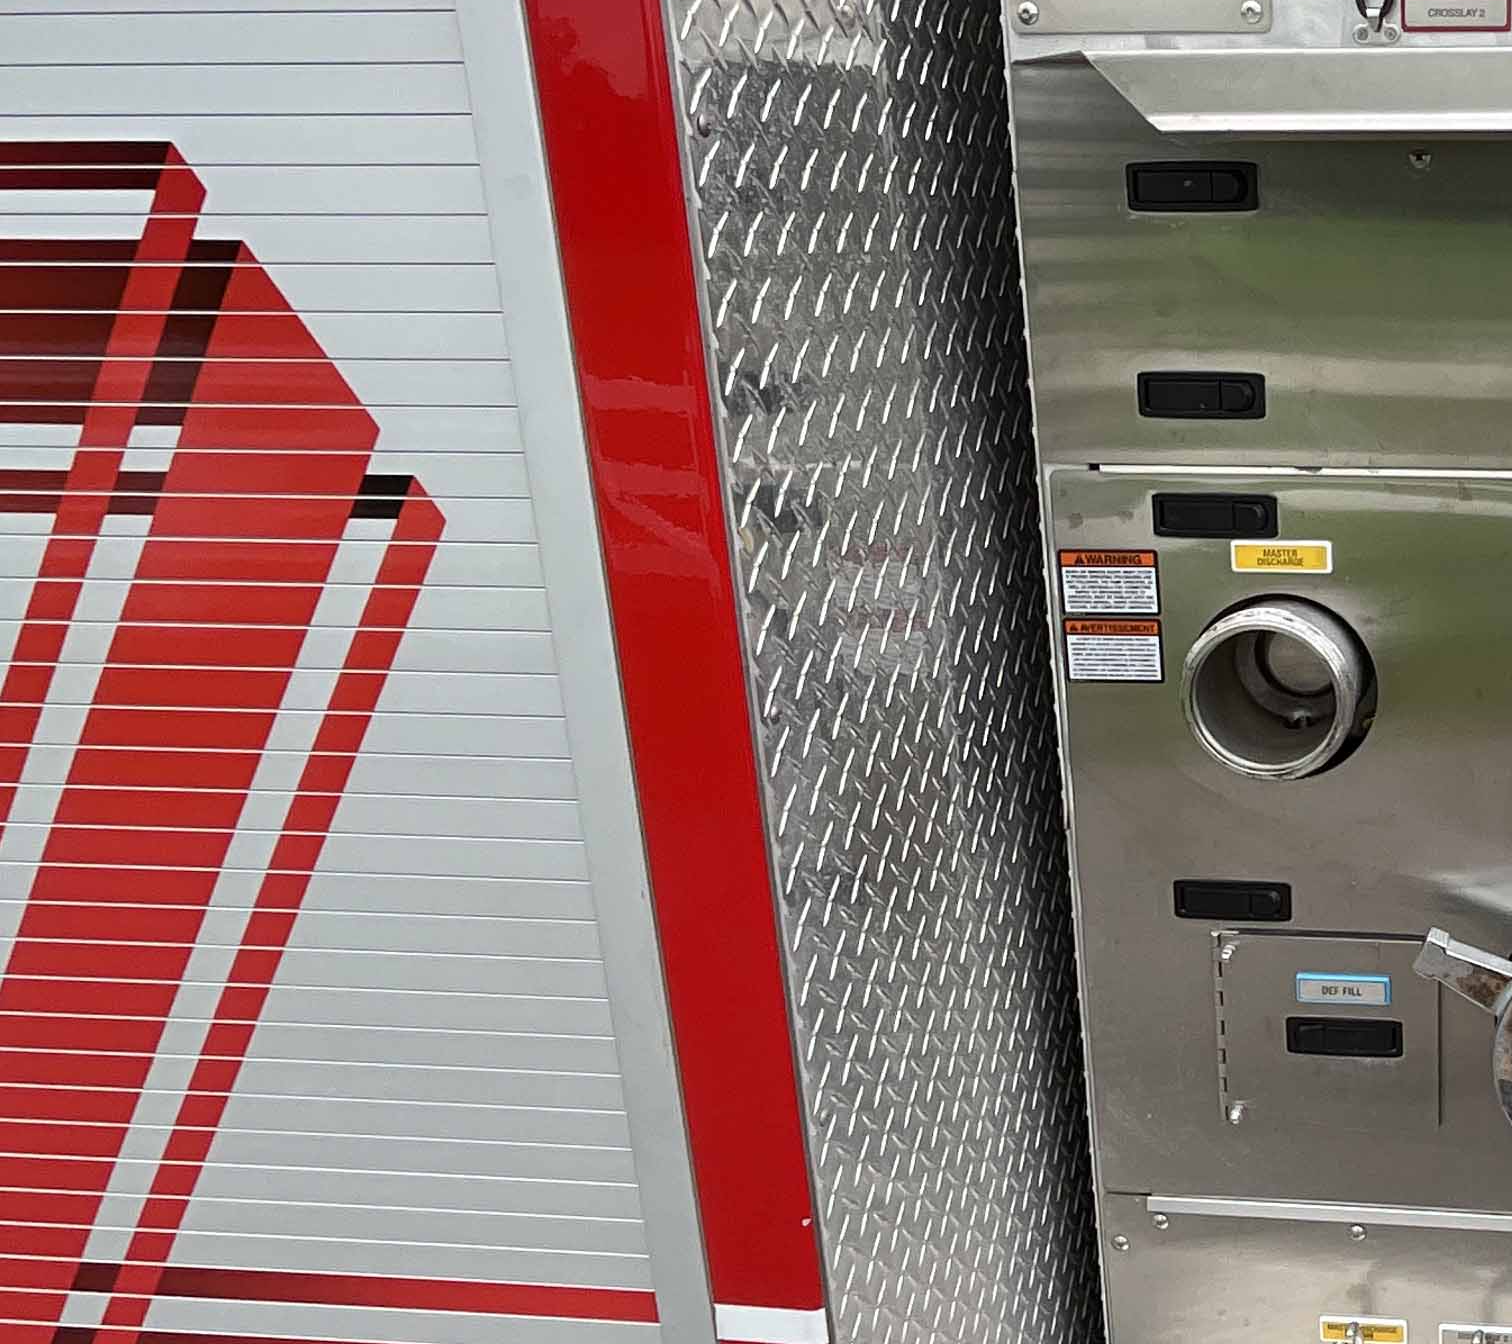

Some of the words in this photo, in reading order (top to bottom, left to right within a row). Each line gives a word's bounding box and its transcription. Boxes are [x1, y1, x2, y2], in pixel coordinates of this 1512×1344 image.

[1427, 8, 1477, 17] CROSSLAY
[1263, 549, 1298, 557] MASTER
[1084, 555, 1142, 565] WARNING
[1256, 558, 1303, 566] DISCHARGE
[1321, 985, 1339, 996] DEF
[1342, 986, 1362, 996] FILL
